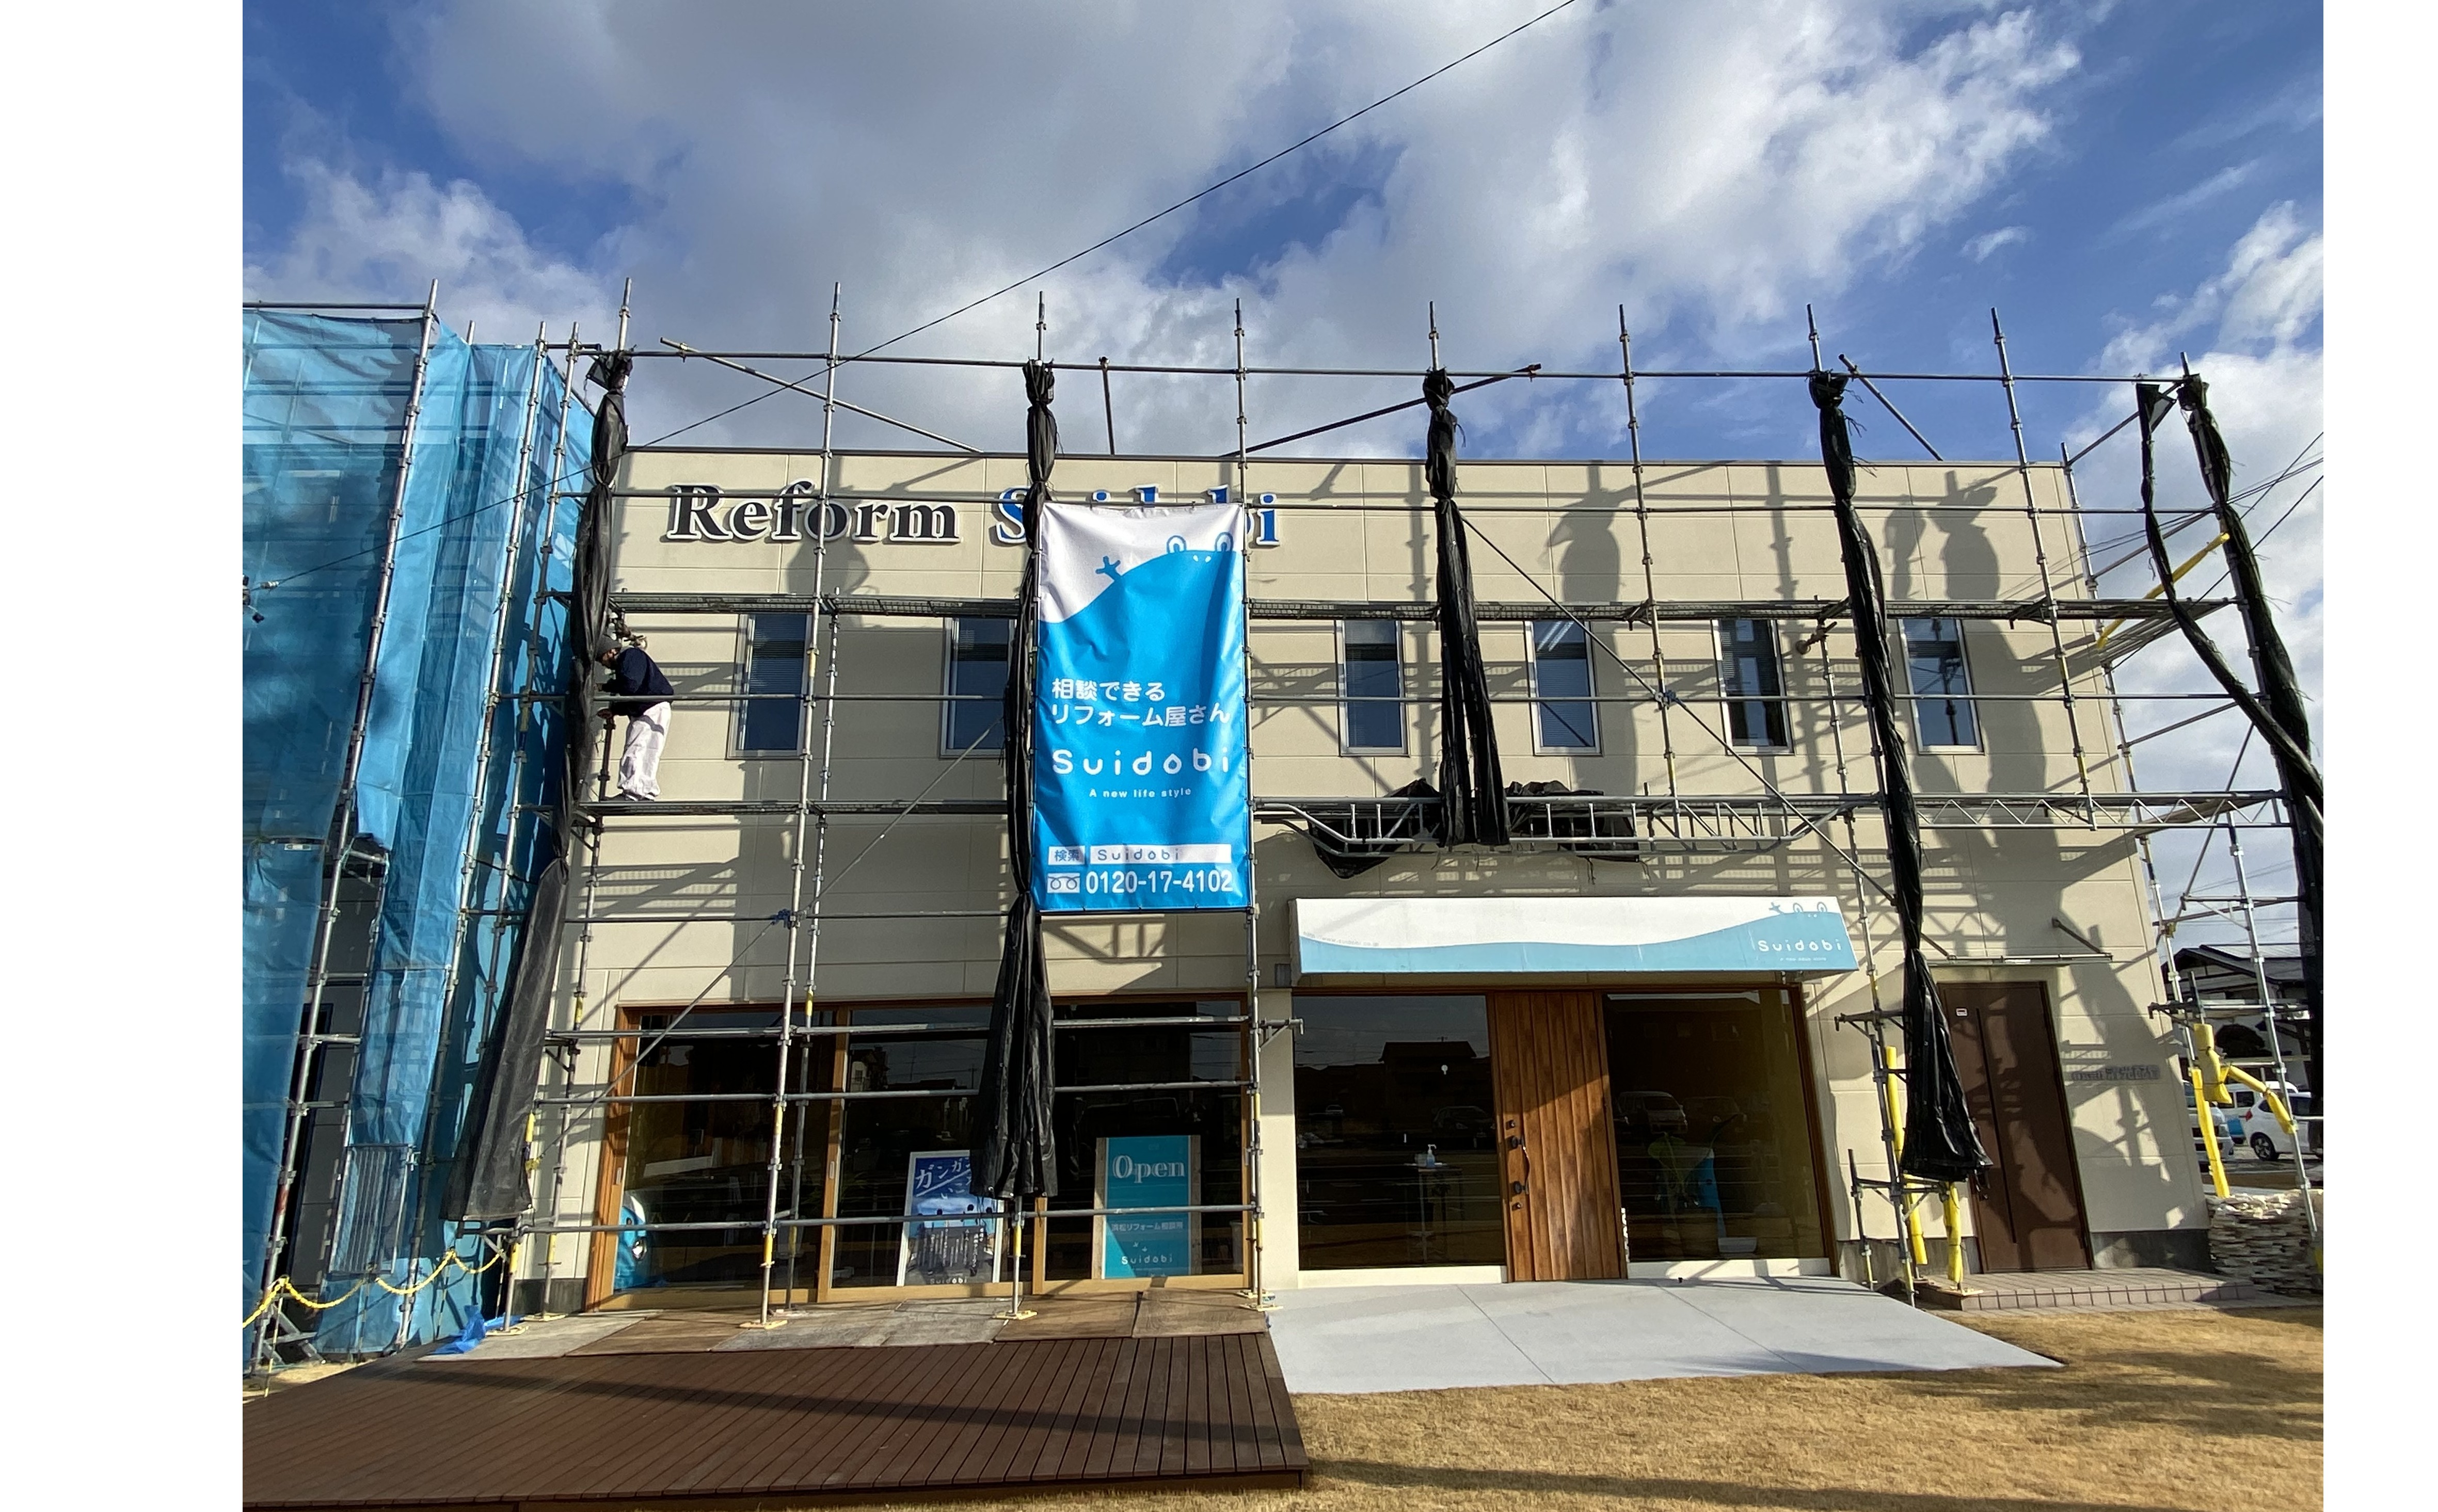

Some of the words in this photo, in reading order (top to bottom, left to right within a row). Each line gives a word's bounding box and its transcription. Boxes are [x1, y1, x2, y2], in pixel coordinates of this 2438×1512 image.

[666, 478, 961, 542] Reform
[1051, 678, 1166, 702] 相談できる
[1051, 702, 1230, 727] リフォーム屋さん
[1052, 747, 1229, 776] Suidobi
[1089, 789, 1097, 798] A
[1134, 789, 1155, 798] life
[1161, 788, 1191, 798] style
[1054, 849, 1080, 862] 検索
[1097, 848, 1180, 861] Suidobi
[1085, 870, 1234, 894] 0120-17-4102
[1758, 939, 1841, 952] Suidobi
[1112, 1155, 1185, 1183] Open
[1121, 1253, 1173, 1265] Suidobi
